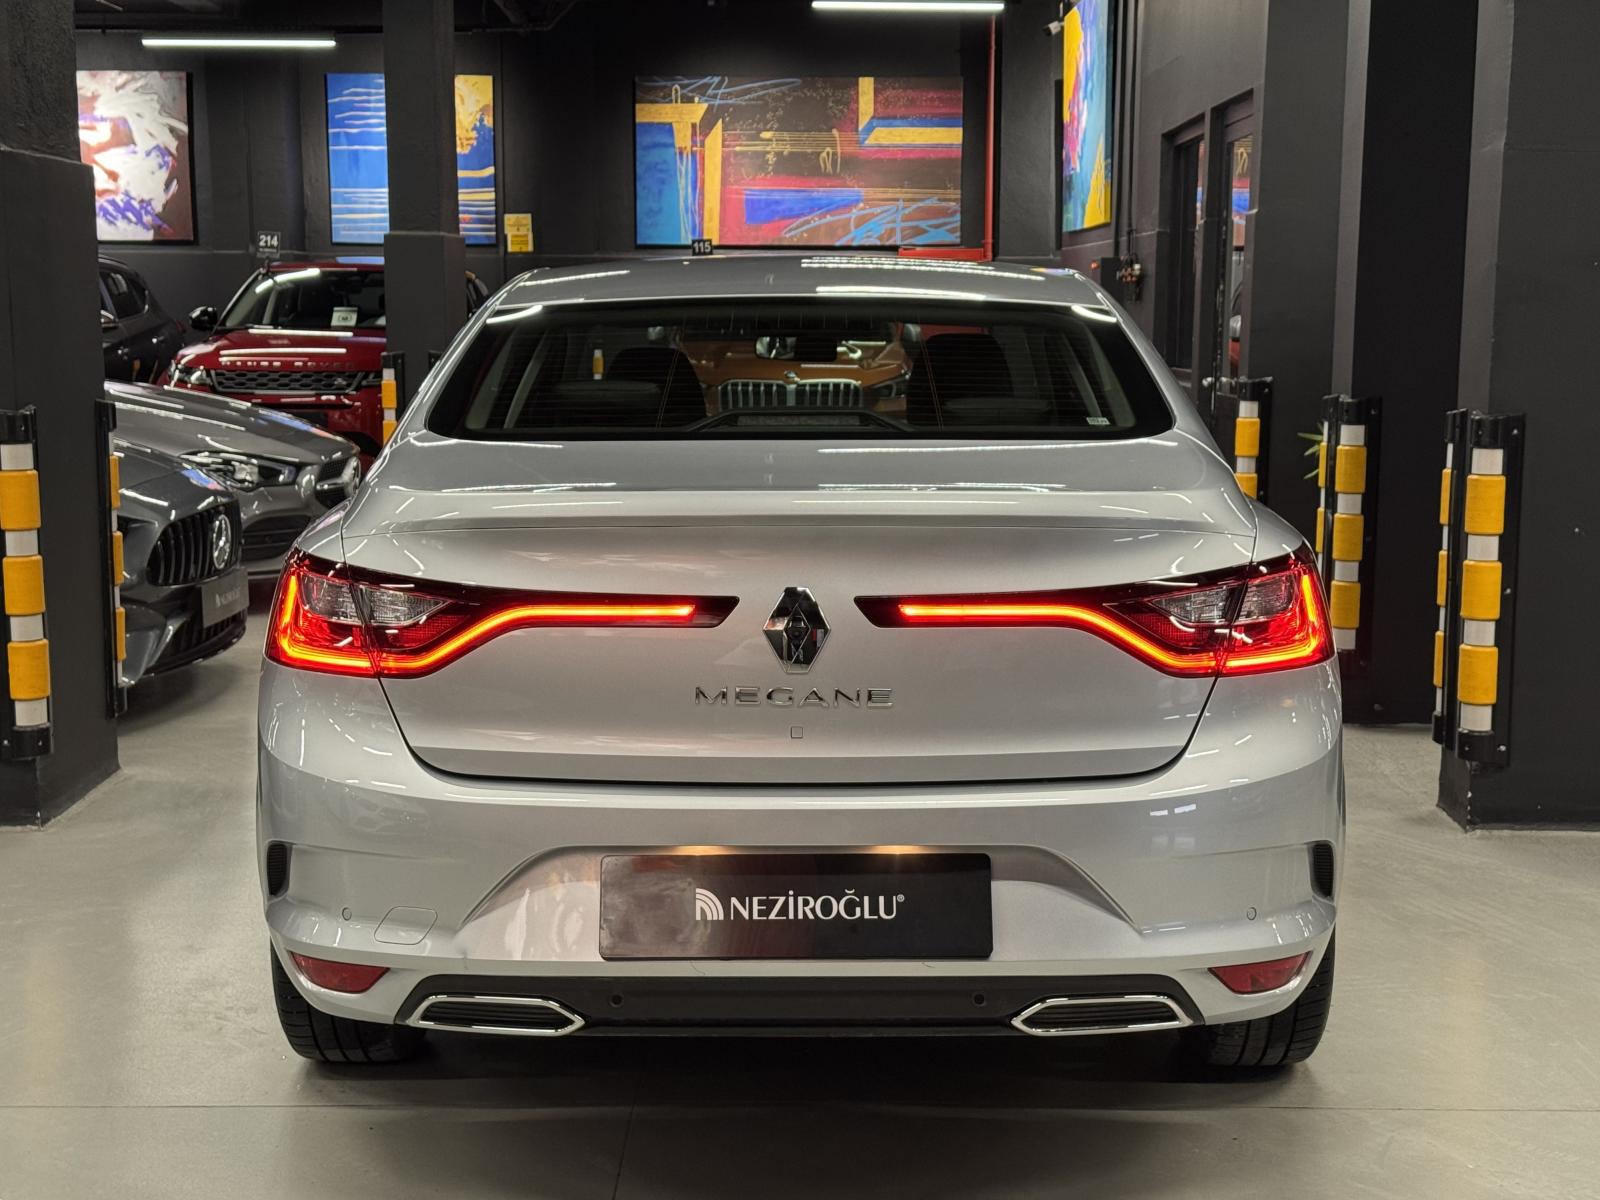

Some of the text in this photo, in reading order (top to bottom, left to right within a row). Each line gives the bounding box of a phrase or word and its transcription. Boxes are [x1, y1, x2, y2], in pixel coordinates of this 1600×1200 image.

[258, 234, 279, 247] 214
[693, 241, 712, 253] 115
[695, 686, 894, 708] MEGANE
